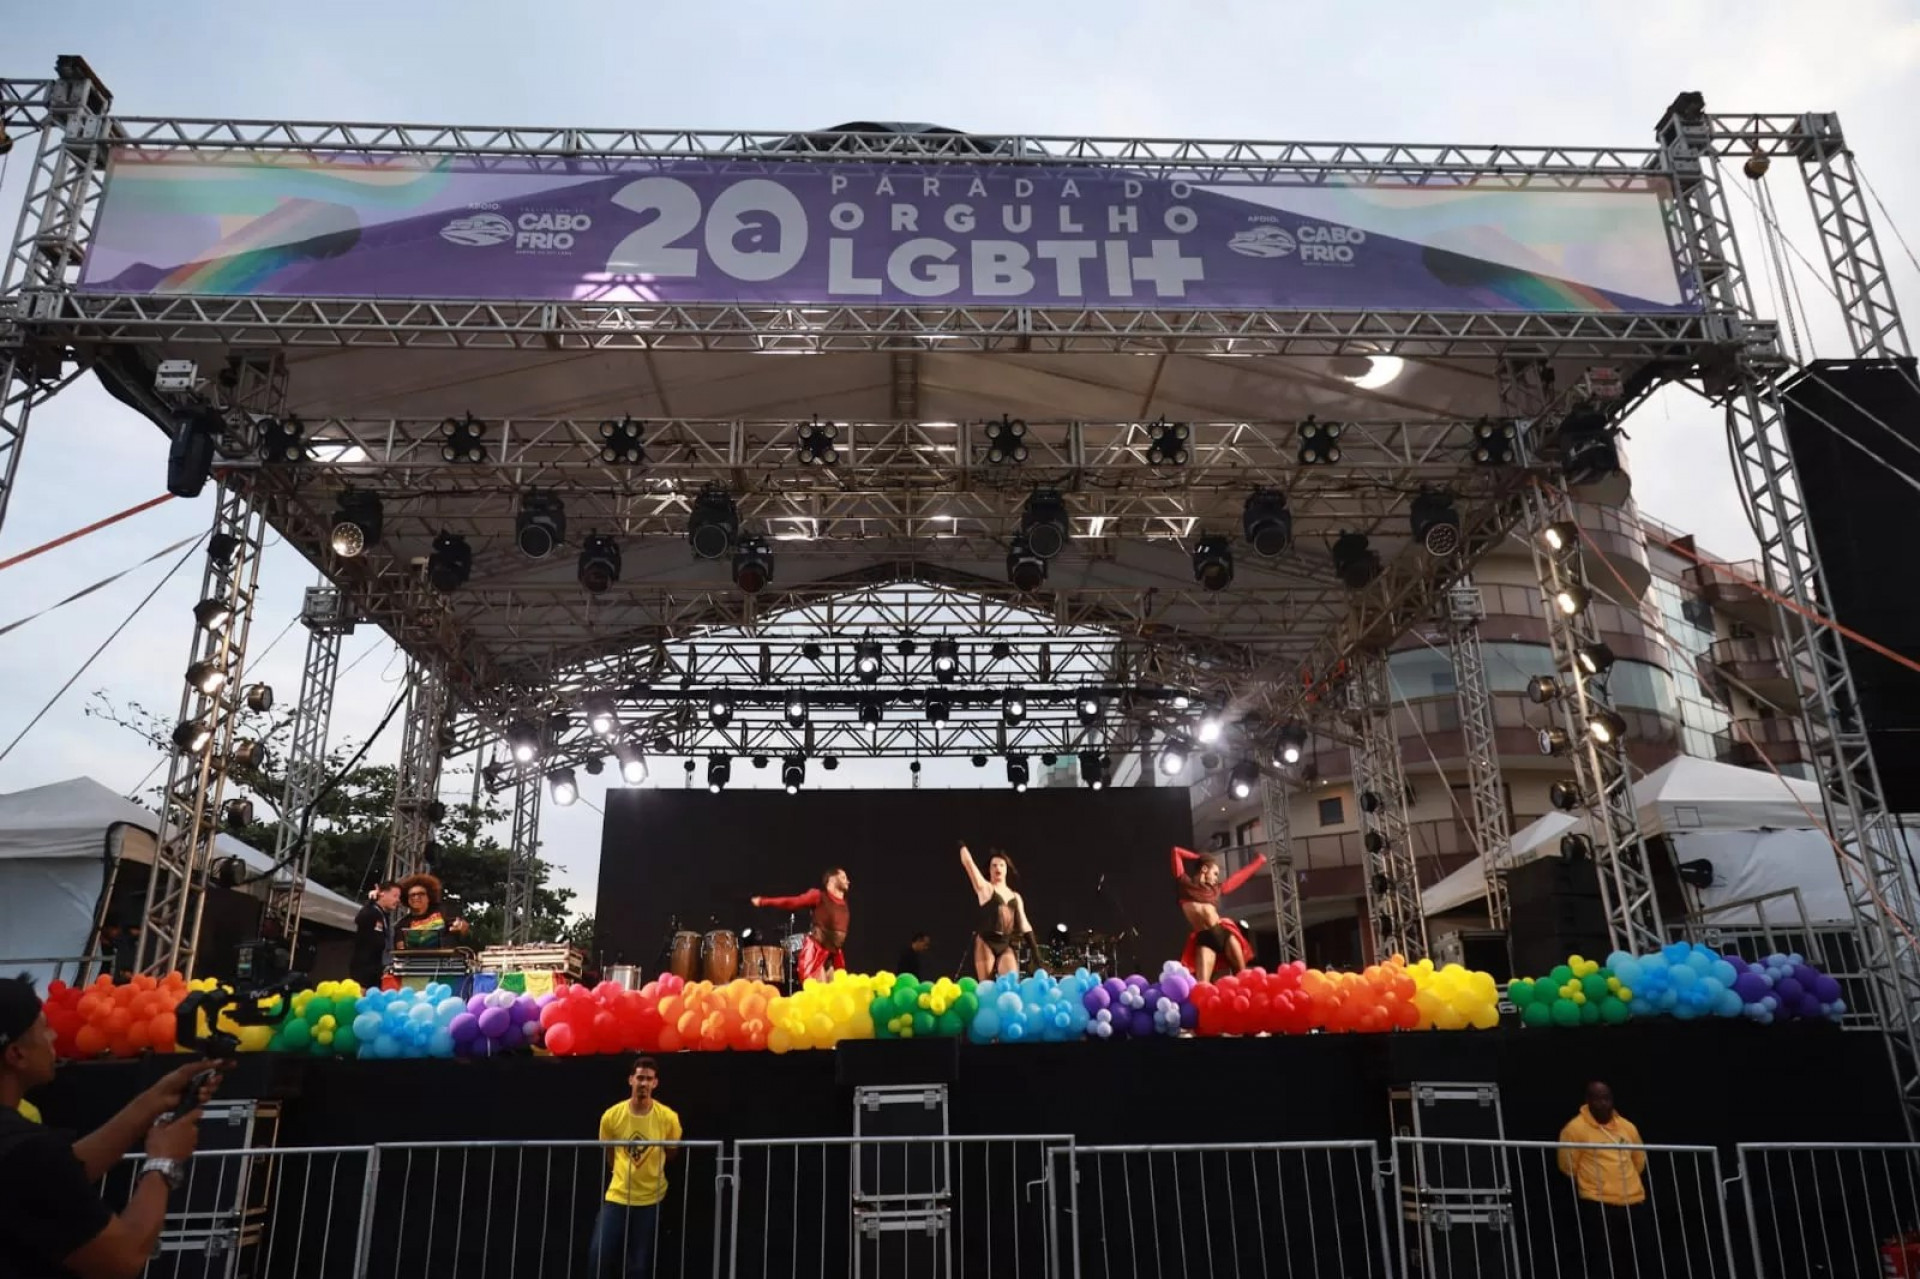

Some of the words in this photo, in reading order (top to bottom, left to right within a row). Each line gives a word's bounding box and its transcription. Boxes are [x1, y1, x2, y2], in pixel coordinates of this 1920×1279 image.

[831, 175, 1080, 198] PARADA
[1124, 180, 1192, 199] DO
[517, 213, 591, 231] CABO
[829, 202, 1198, 233] ORGULHO
[516, 232, 574, 249] FRIO
[1297, 226, 1365, 244] CABO
[1299, 244, 1354, 262] FRIO
[828, 237, 1204, 297] LGBTI+
